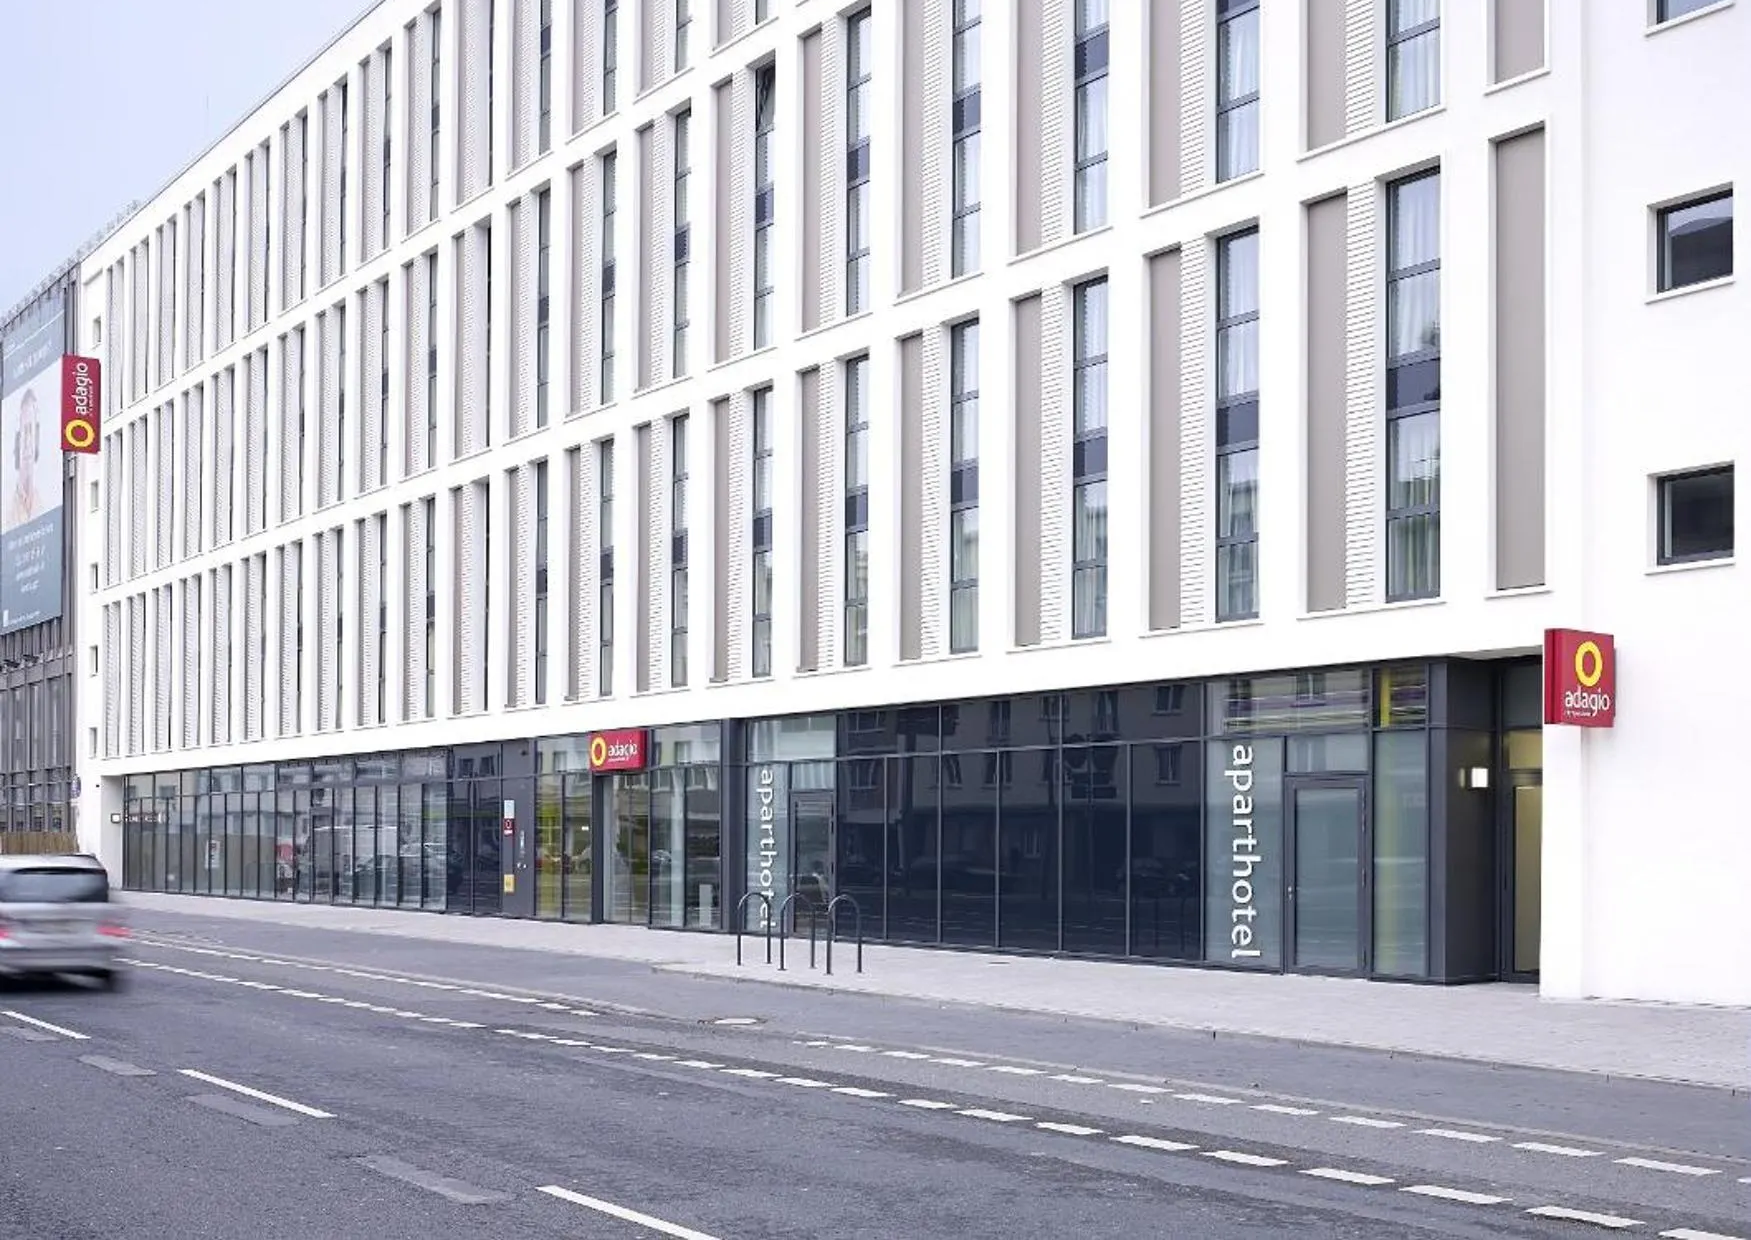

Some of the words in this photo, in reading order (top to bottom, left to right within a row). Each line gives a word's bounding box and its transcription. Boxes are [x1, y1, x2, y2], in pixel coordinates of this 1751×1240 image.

[72, 362, 93, 416] adagio
[1565, 684, 1610, 717] adagio
[1224, 744, 1262, 959] aparthotel
